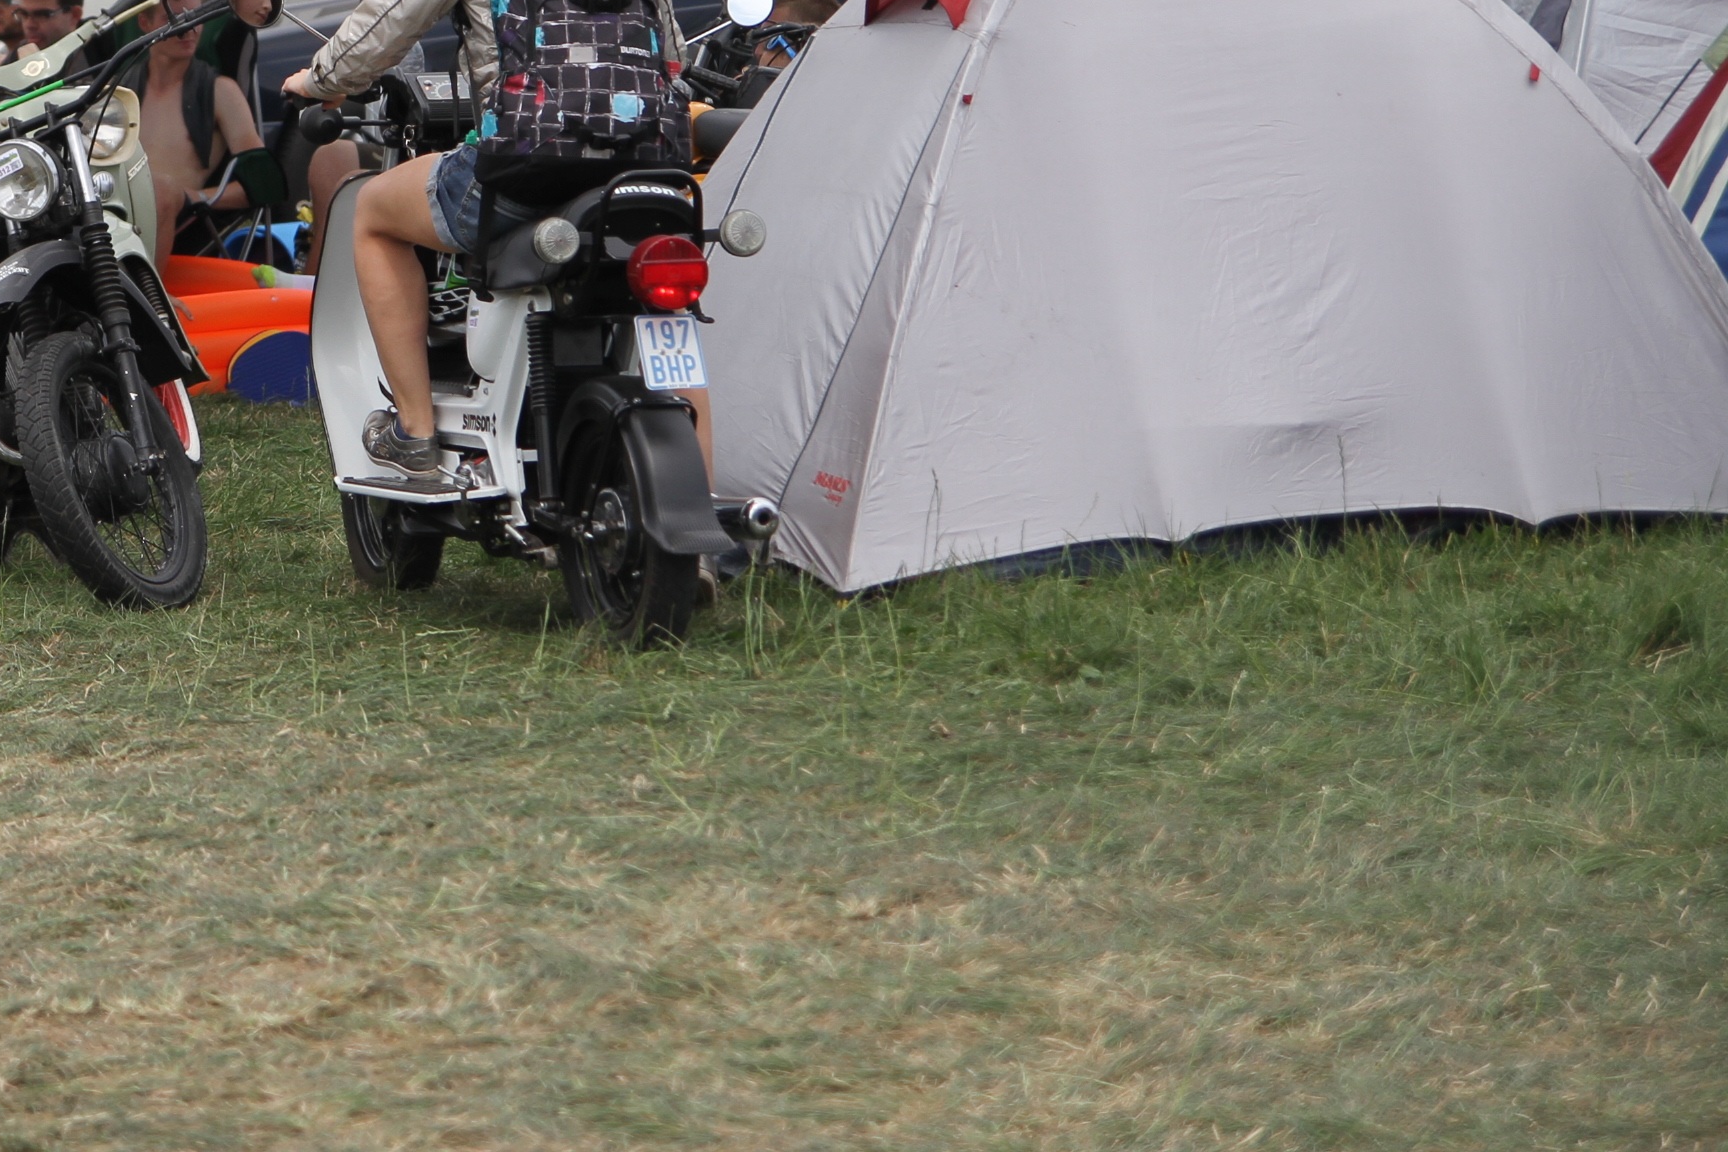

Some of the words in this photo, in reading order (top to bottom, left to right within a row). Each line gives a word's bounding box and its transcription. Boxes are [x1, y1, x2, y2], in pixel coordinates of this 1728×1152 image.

[613, 185, 676, 197] imson
[645, 320, 689, 350] 197
[650, 354, 696, 383] BHP
[462, 413, 491, 432] simson
